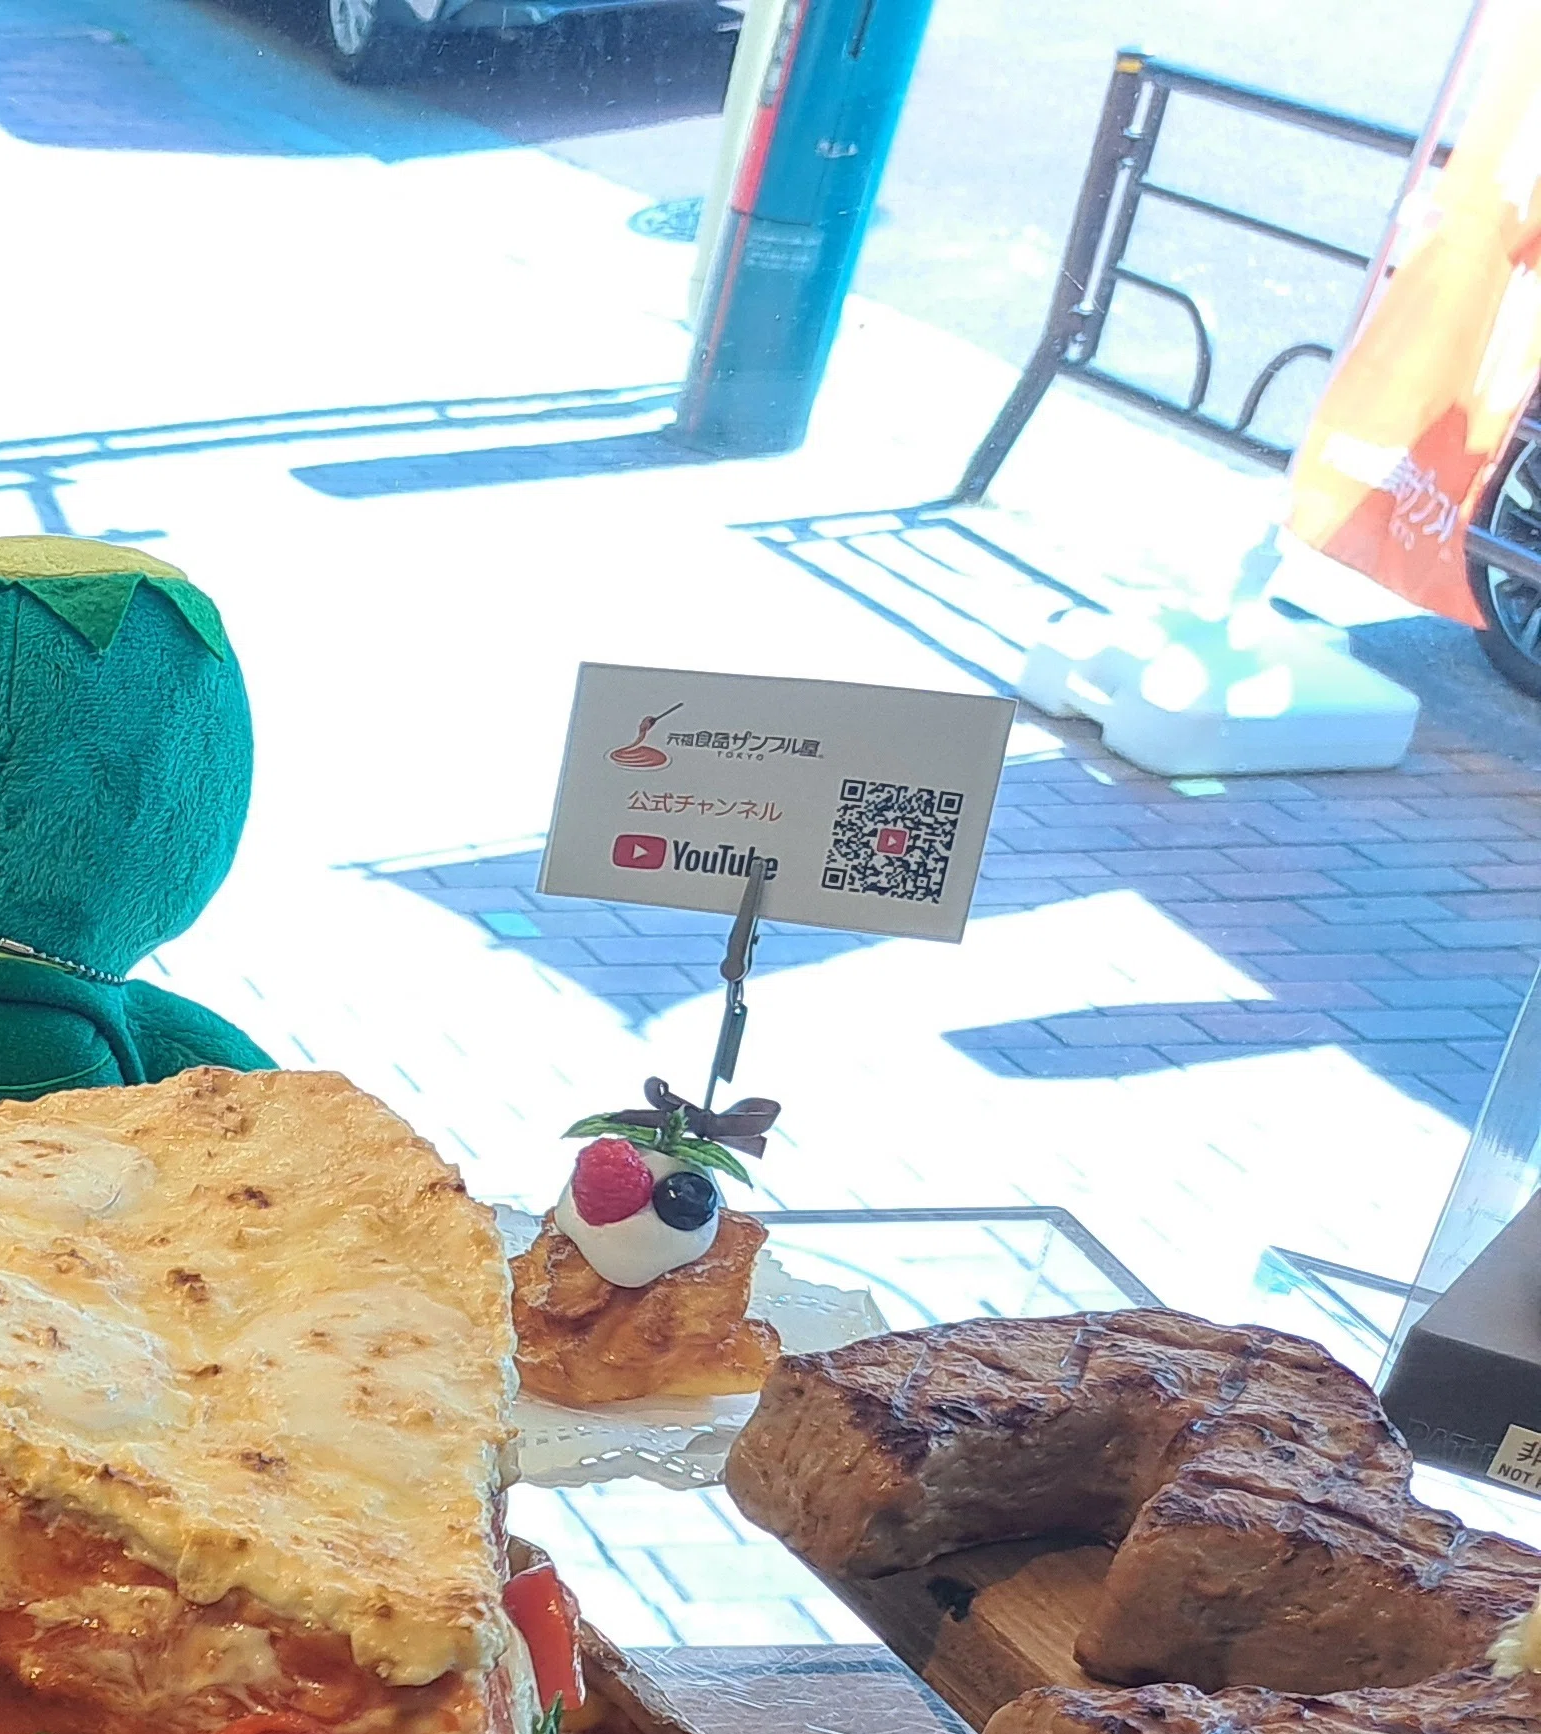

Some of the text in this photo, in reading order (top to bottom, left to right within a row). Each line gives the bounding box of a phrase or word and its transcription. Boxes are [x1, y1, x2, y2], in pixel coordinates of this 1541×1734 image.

[628, 790, 783, 822] 公式チャンネル
[1497, 1463, 1535, 1484] NOT
